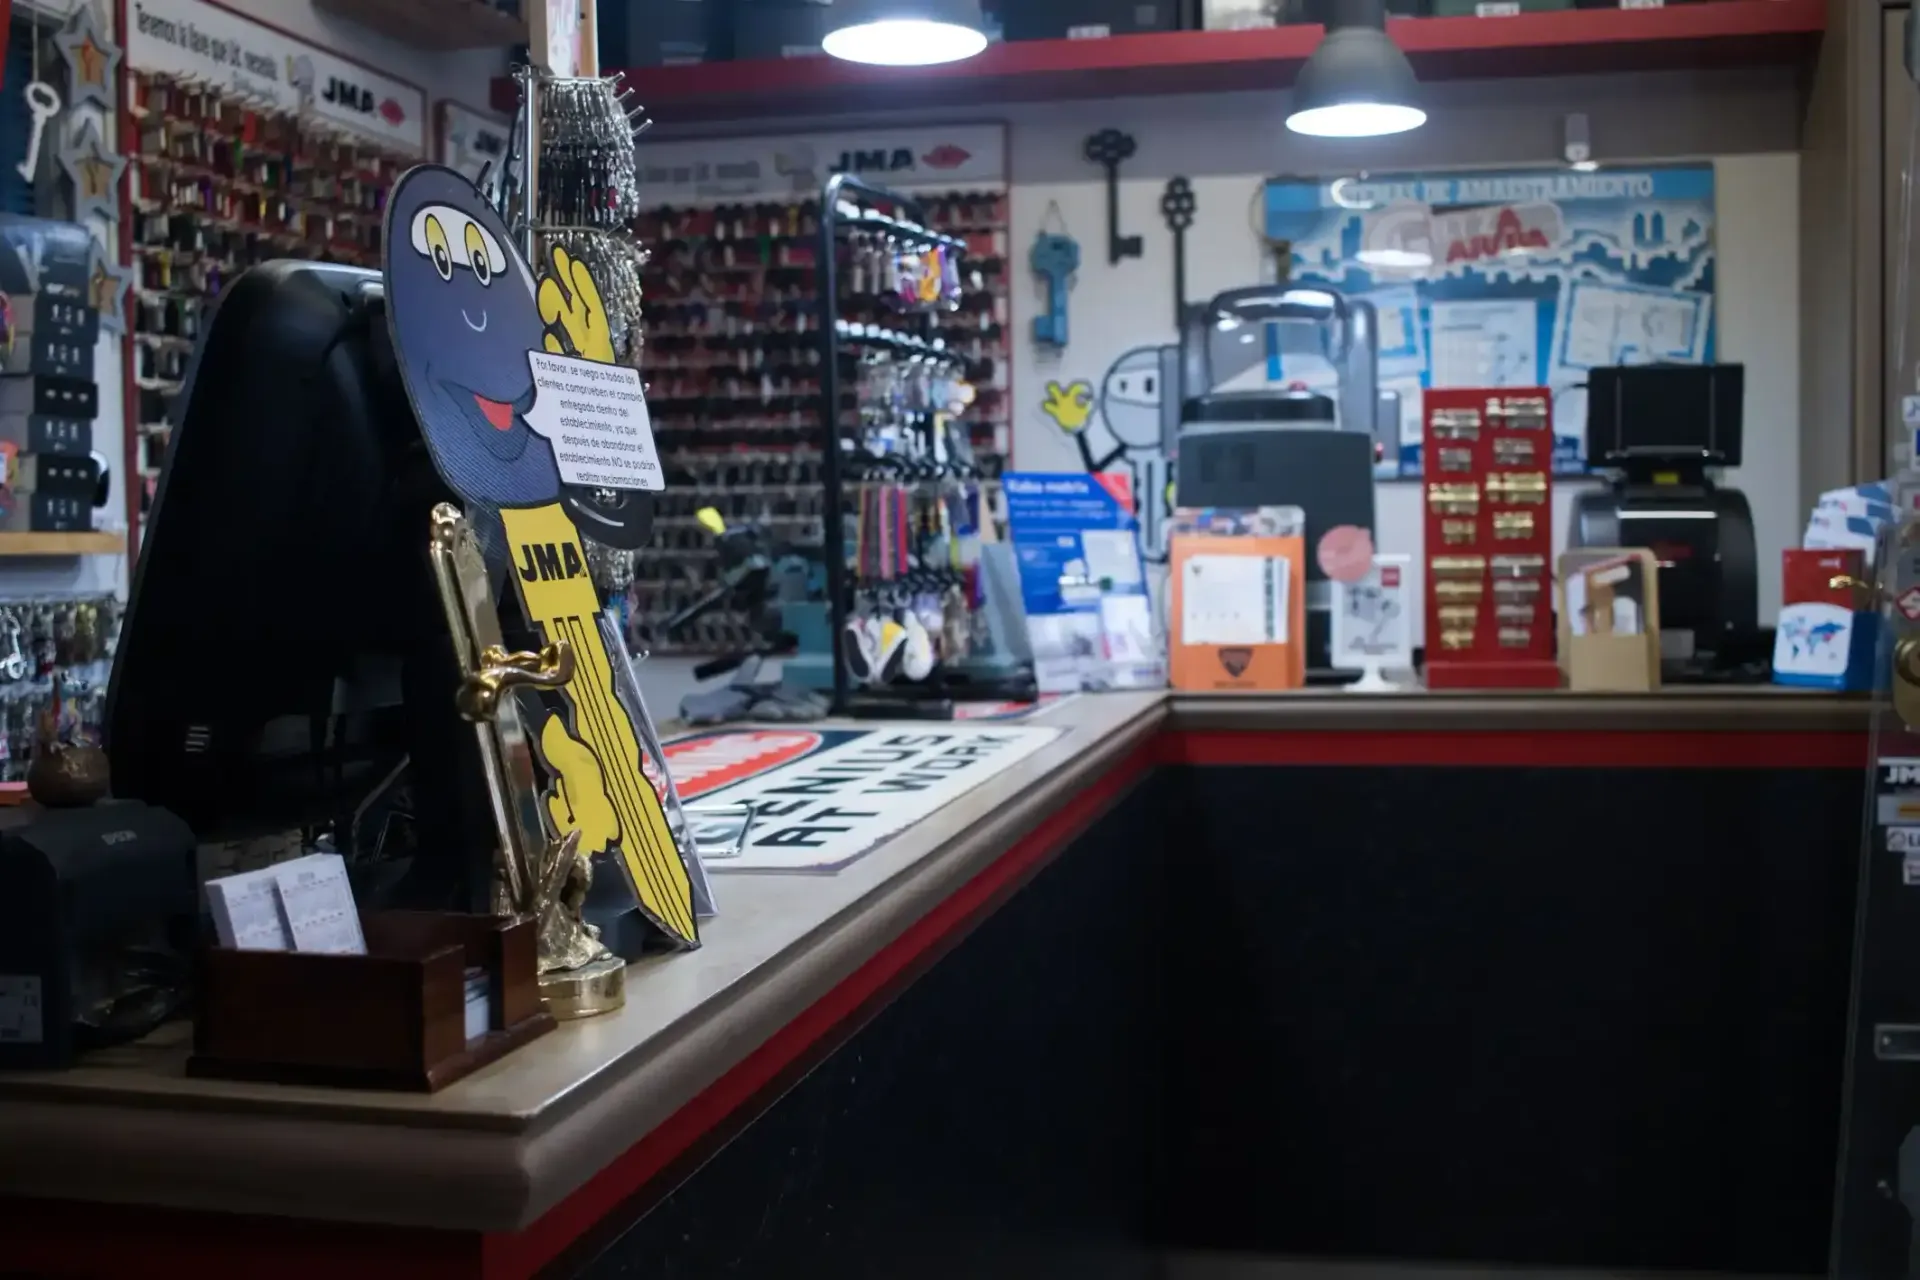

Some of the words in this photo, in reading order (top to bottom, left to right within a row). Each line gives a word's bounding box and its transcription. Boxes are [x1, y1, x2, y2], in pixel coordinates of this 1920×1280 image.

[322, 76, 374, 113] JMA
[828, 147, 917, 173] JMA
[1459, 174, 1654, 201] AMAESTRAMIENTO
[536, 358, 548, 369] Por
[571, 367, 579, 376] se
[606, 370, 625, 384] todos
[625, 374, 636, 385] los
[537, 376, 564, 391] clientes
[565, 383, 609, 398] comprueben
[609, 389, 616, 398] el
[617, 391, 643, 402] cambio
[560, 399, 595, 413] entregado
[596, 403, 618, 416] dentro
[618, 407, 629, 418] del
[616, 426, 624, 435] ya
[624, 426, 638, 437] que
[591, 438, 600, 448] de
[601, 439, 636, 452] abandonar
[637, 443, 644, 453] el
[560, 451, 611, 467] establecimiento
[611, 456, 624, 467] NO
[624, 460, 632, 468] se
[600, 474, 648, 487] reclamaciones
[519, 542, 582, 583] JMA
[752, 806, 881, 847] AT
[859, 734, 1026, 795] WORK
